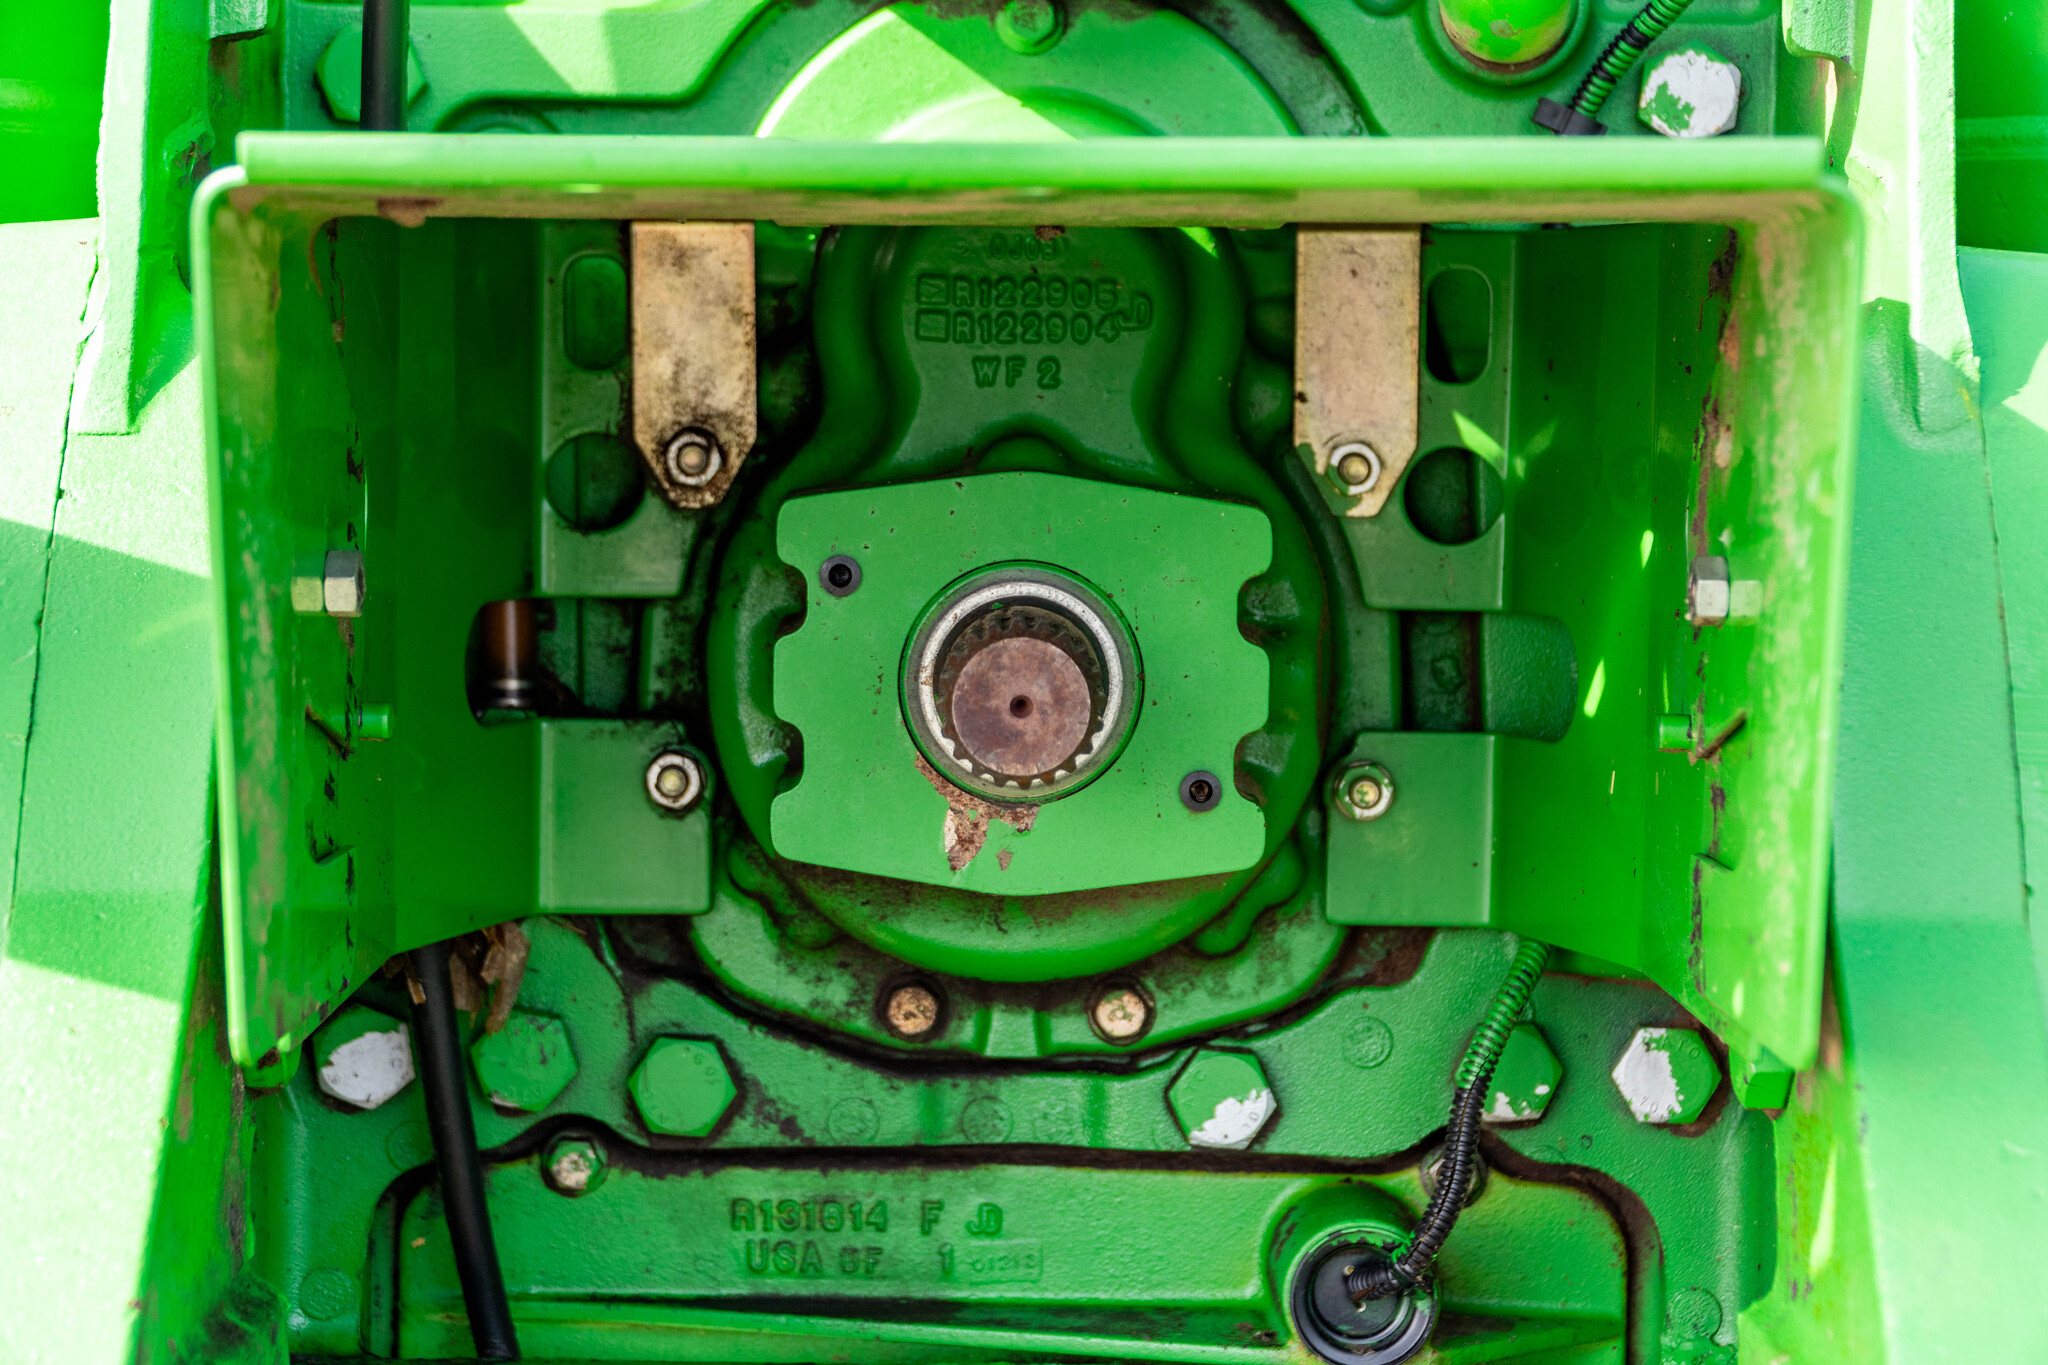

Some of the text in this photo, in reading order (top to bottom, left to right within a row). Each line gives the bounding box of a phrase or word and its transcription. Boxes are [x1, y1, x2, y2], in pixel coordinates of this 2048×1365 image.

[952, 274, 1118, 311] R122905
[952, 311, 1120, 345] R122904
[971, 355, 1061, 389] WF 2
[920, 1199, 945, 1236] F
[965, 1202, 1004, 1236] JD
[745, 1238, 824, 1274] USA
